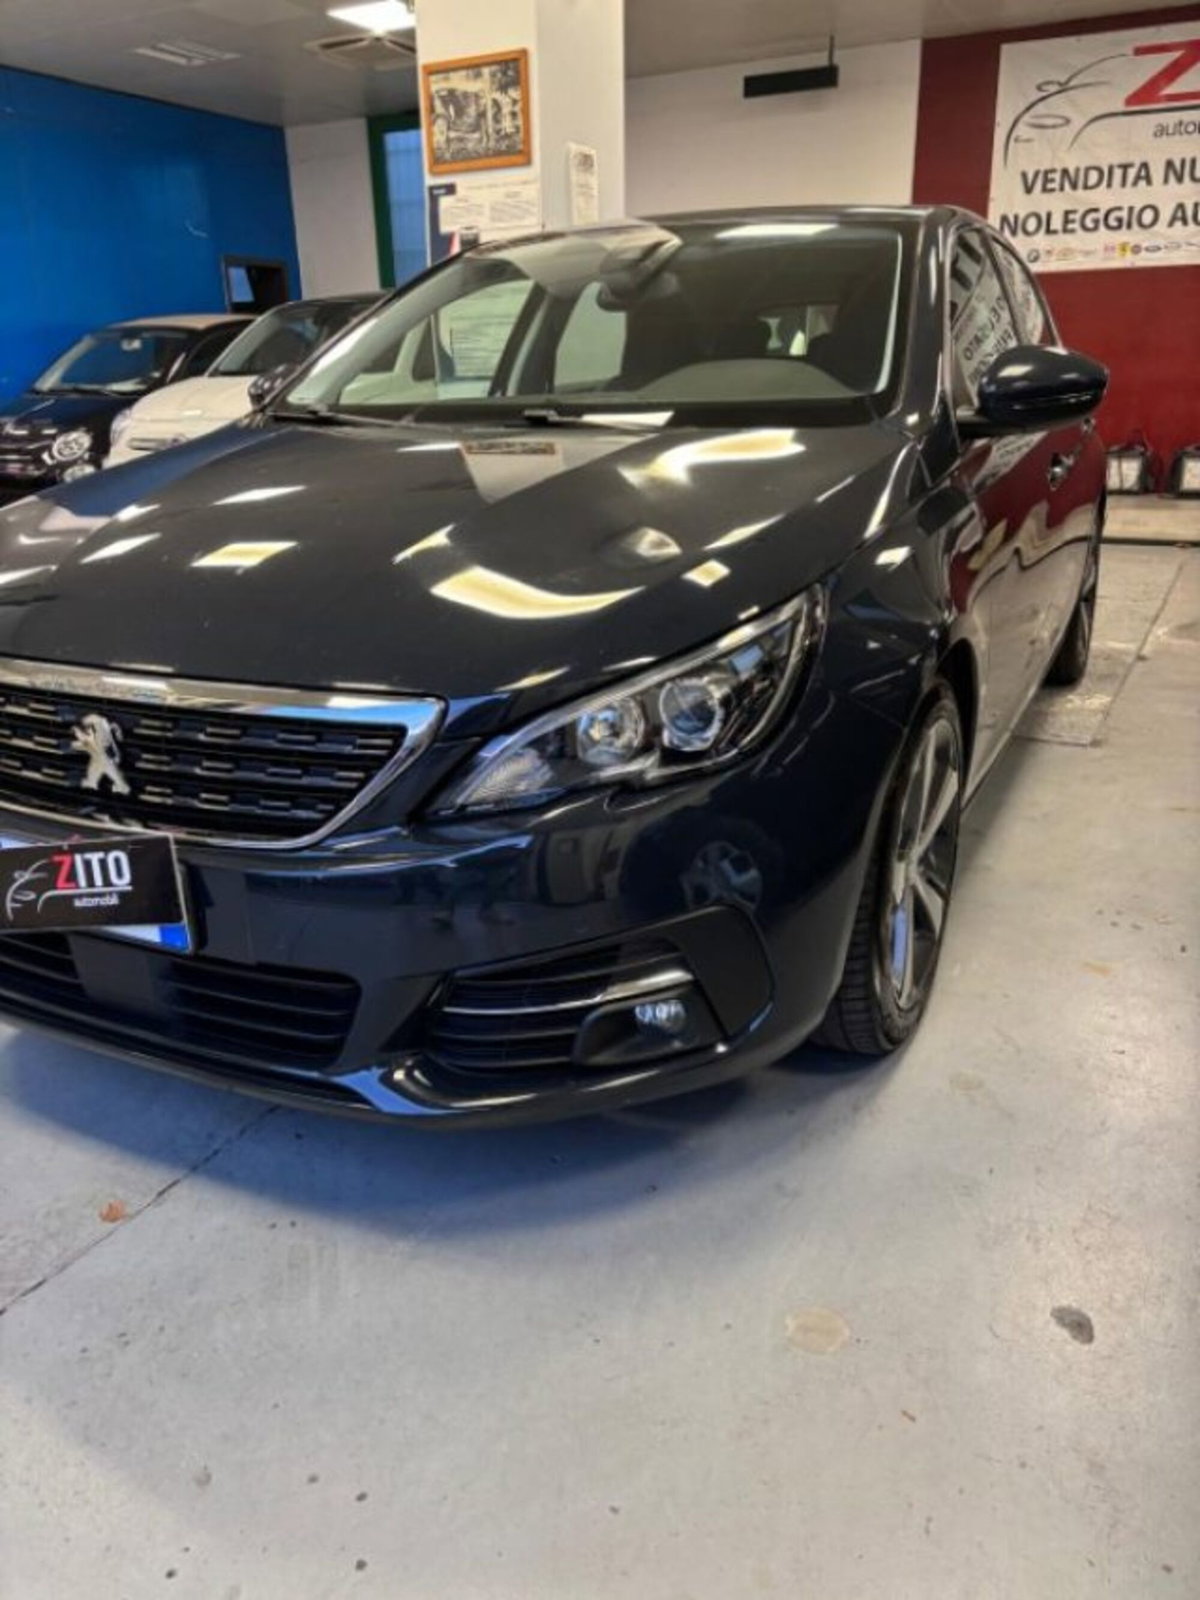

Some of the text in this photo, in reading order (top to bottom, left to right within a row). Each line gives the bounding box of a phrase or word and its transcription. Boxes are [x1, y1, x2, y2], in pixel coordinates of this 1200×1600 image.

[1020, 161, 1153, 195] VENDITA
[1000, 203, 1160, 238] NOLEGGIO
[53, 850, 132, 890] ZITO
